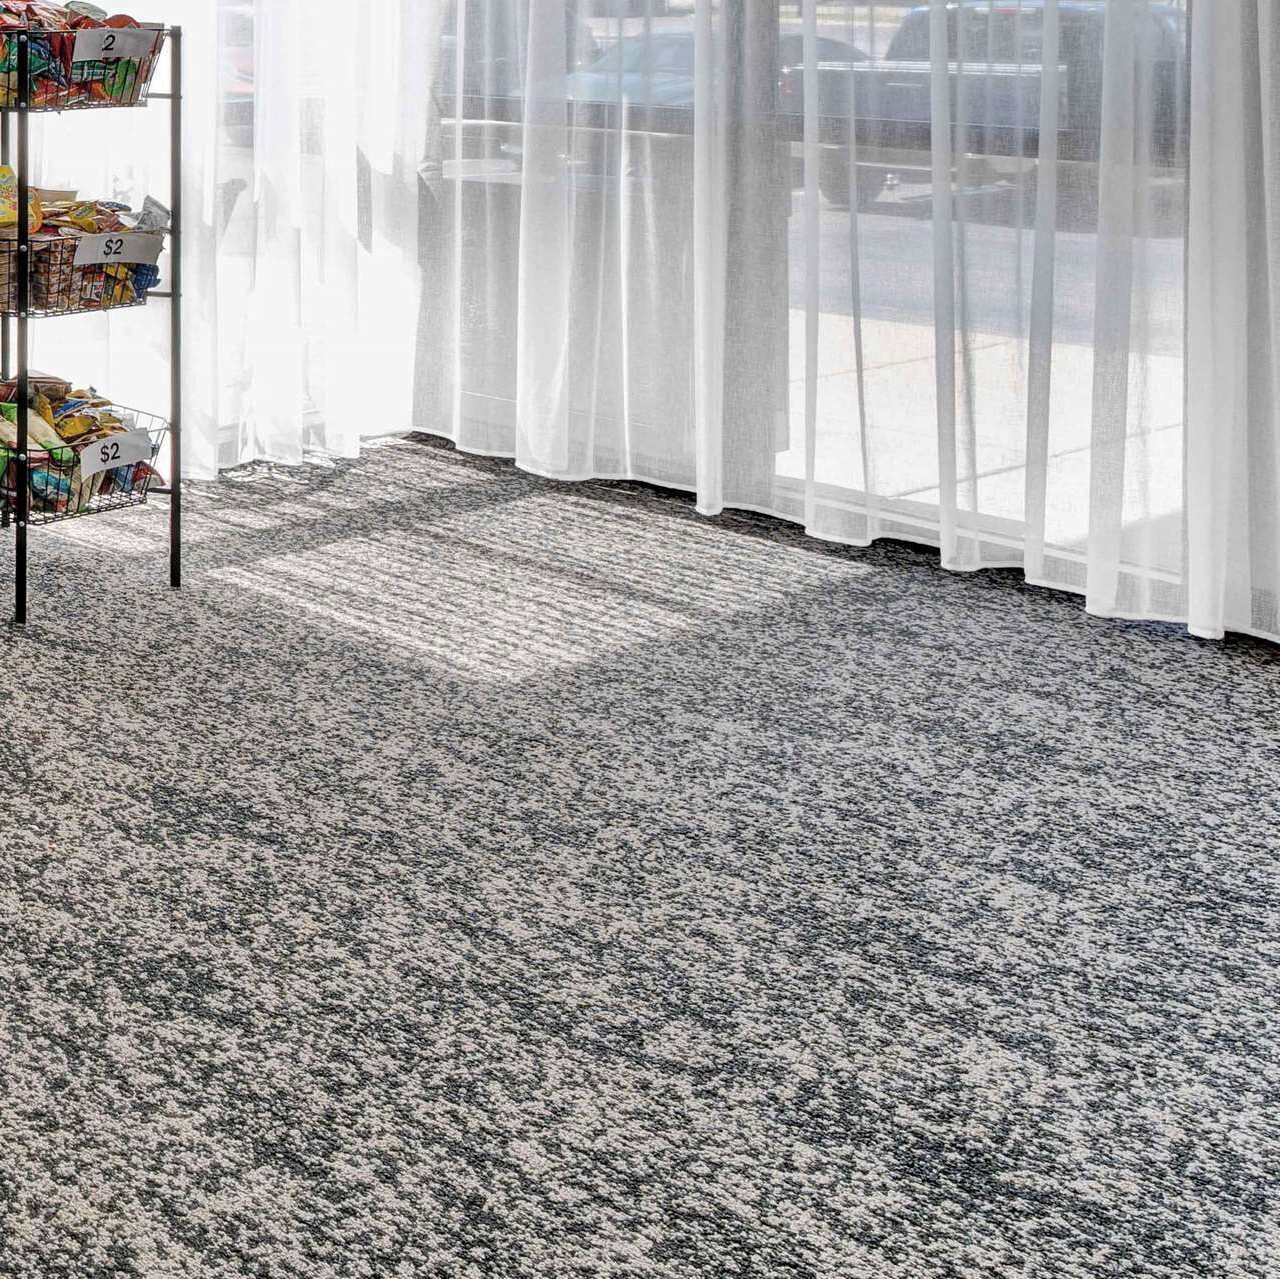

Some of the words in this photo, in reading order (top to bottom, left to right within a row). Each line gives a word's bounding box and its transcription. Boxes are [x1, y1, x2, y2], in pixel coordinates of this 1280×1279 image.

[102, 34, 116, 51] 2
[103, 239, 123, 258] $2
[100, 443, 120, 463] $2
